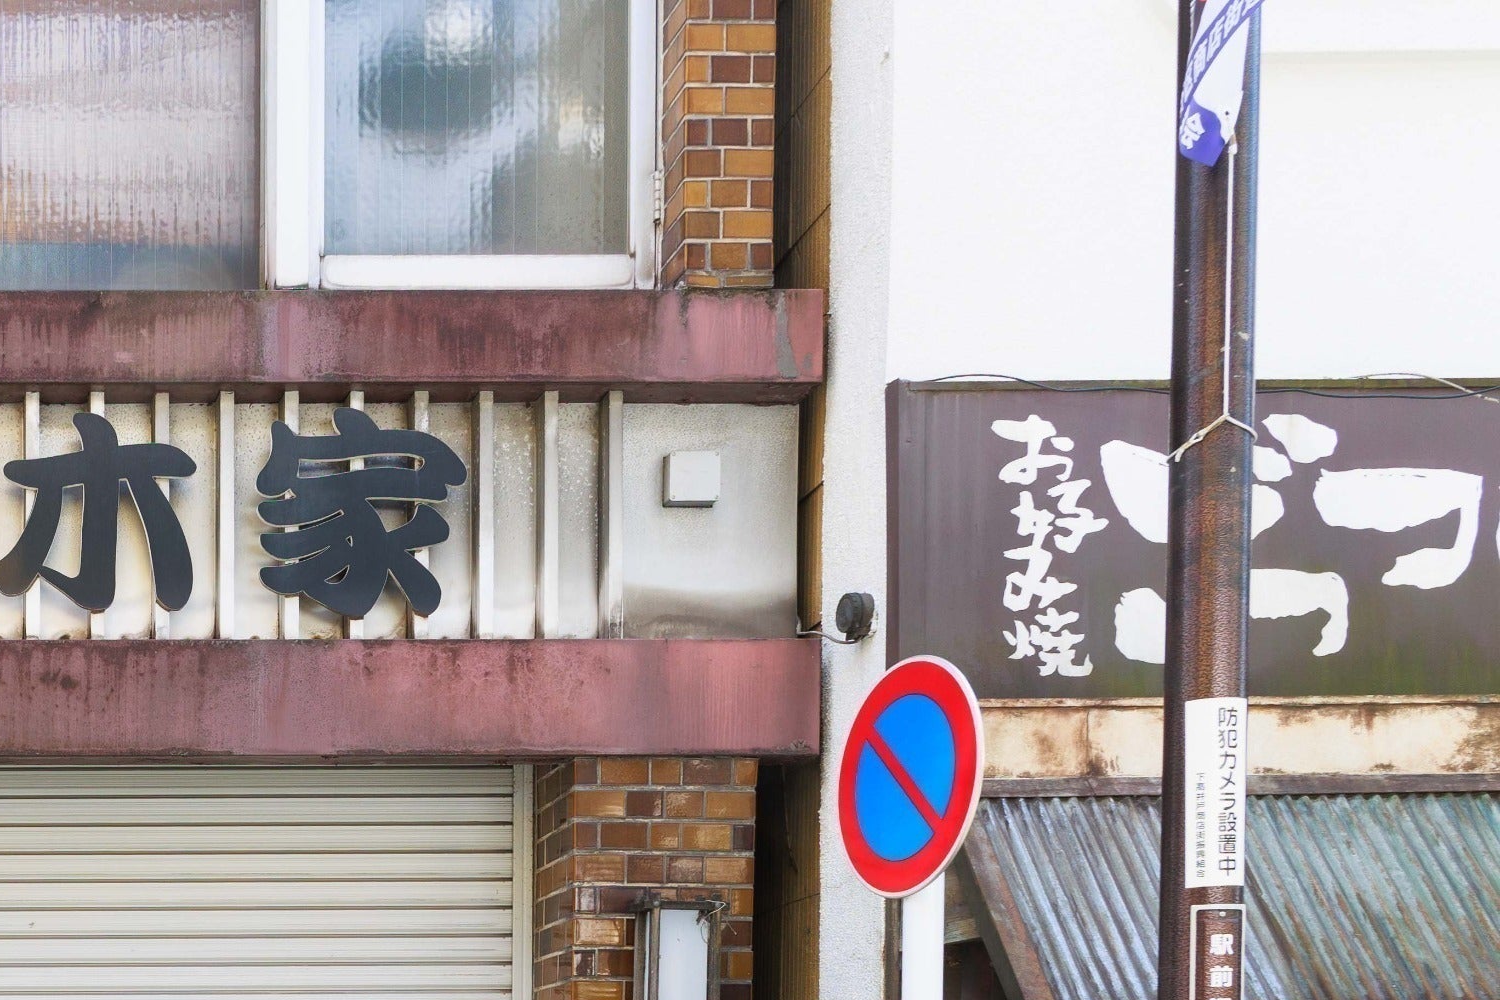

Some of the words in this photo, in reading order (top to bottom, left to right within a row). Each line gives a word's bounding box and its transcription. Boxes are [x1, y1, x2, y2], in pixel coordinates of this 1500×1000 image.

[992, 414, 1109, 677] お好み焼
[1218, 707, 1238, 876] 防犯カメラ設置中
